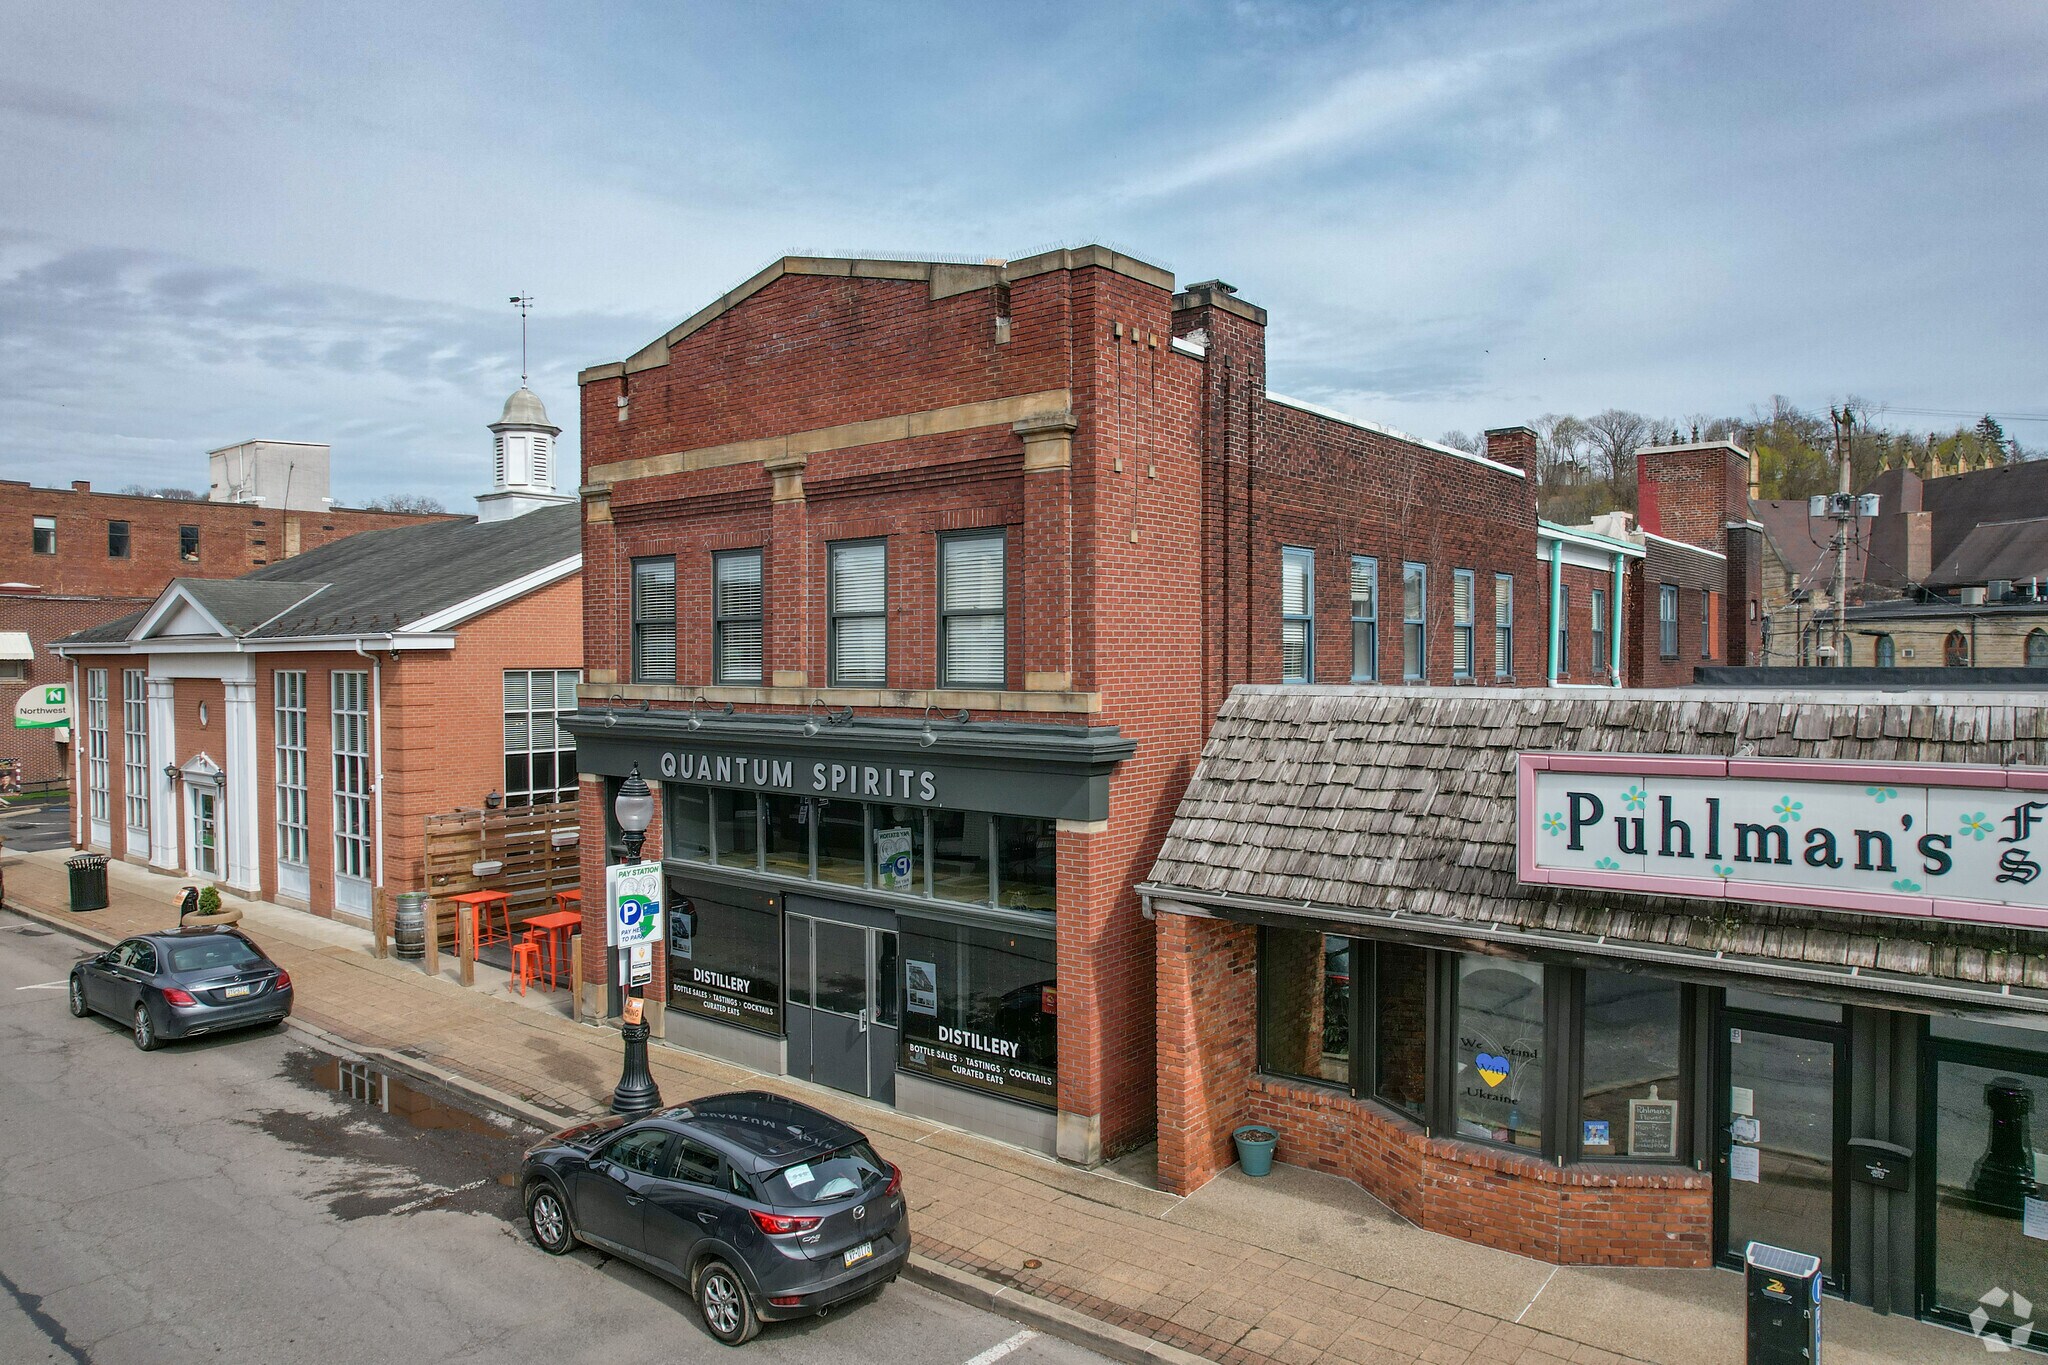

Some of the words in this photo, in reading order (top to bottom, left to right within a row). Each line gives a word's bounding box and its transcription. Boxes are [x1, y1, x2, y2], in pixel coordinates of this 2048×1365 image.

[660, 752, 793, 788] QUANTUM
[812, 762, 936, 801] SPIRITS
[1566, 791, 1953, 876] Puhlman's
[618, 870, 631, 878] PAY
[632, 865, 659, 876] STATION
[623, 902, 638, 924] P
[621, 928, 632, 936] PAY
[693, 967, 751, 994] DISTILLERY
[673, 984, 692, 995] BOTTLE
[692, 989, 708, 999] SALES
[713, 993, 738, 1007] TASTINGS
[743, 1002, 774, 1016] COCKTAILS
[703, 1001, 727, 1013] CURATED
[727, 1009, 740, 1017] EATS
[938, 1025, 1019, 1058] DISTILLERY
[1460, 1038, 1482, 1049] We
[1503, 1045, 1538, 1059] Stand
[909, 1043, 935, 1056] BOTTLE
[936, 1050, 958, 1063] SALES
[965, 1057, 1001, 1073] TASTINGS
[1009, 1068, 1053, 1086] COCKTAILS
[951, 1065, 984, 1080] CURATED
[986, 1073, 1004, 1085] EATS
[1480, 1063, 1508, 1076] With
[1467, 1087, 1519, 1105] Ukraine
